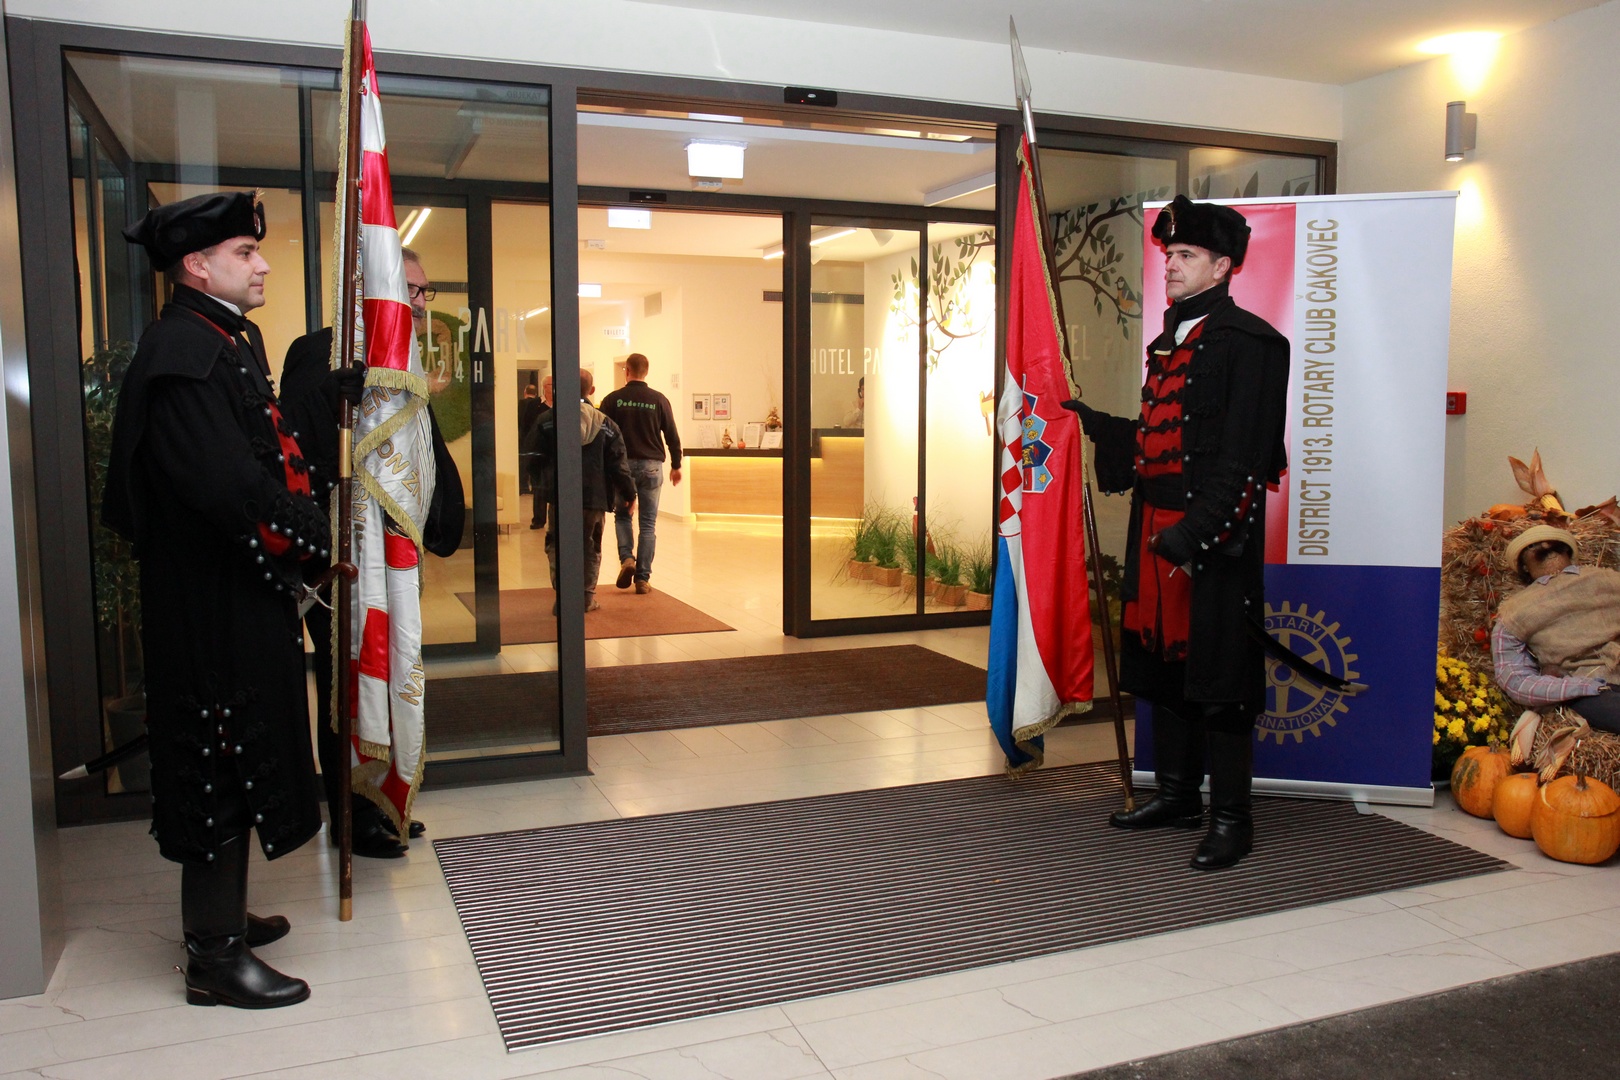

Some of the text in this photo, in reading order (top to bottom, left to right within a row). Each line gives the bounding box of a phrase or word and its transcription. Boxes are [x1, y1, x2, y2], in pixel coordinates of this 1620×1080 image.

[458, 307, 531, 353] PARK
[1296, 218, 1339, 556] DISTRICT 1913. ROTARY CLUB ČAKOVEC
[1264, 616, 1322, 636] OTARY
[1255, 696, 1338, 730] RNATIONAL
